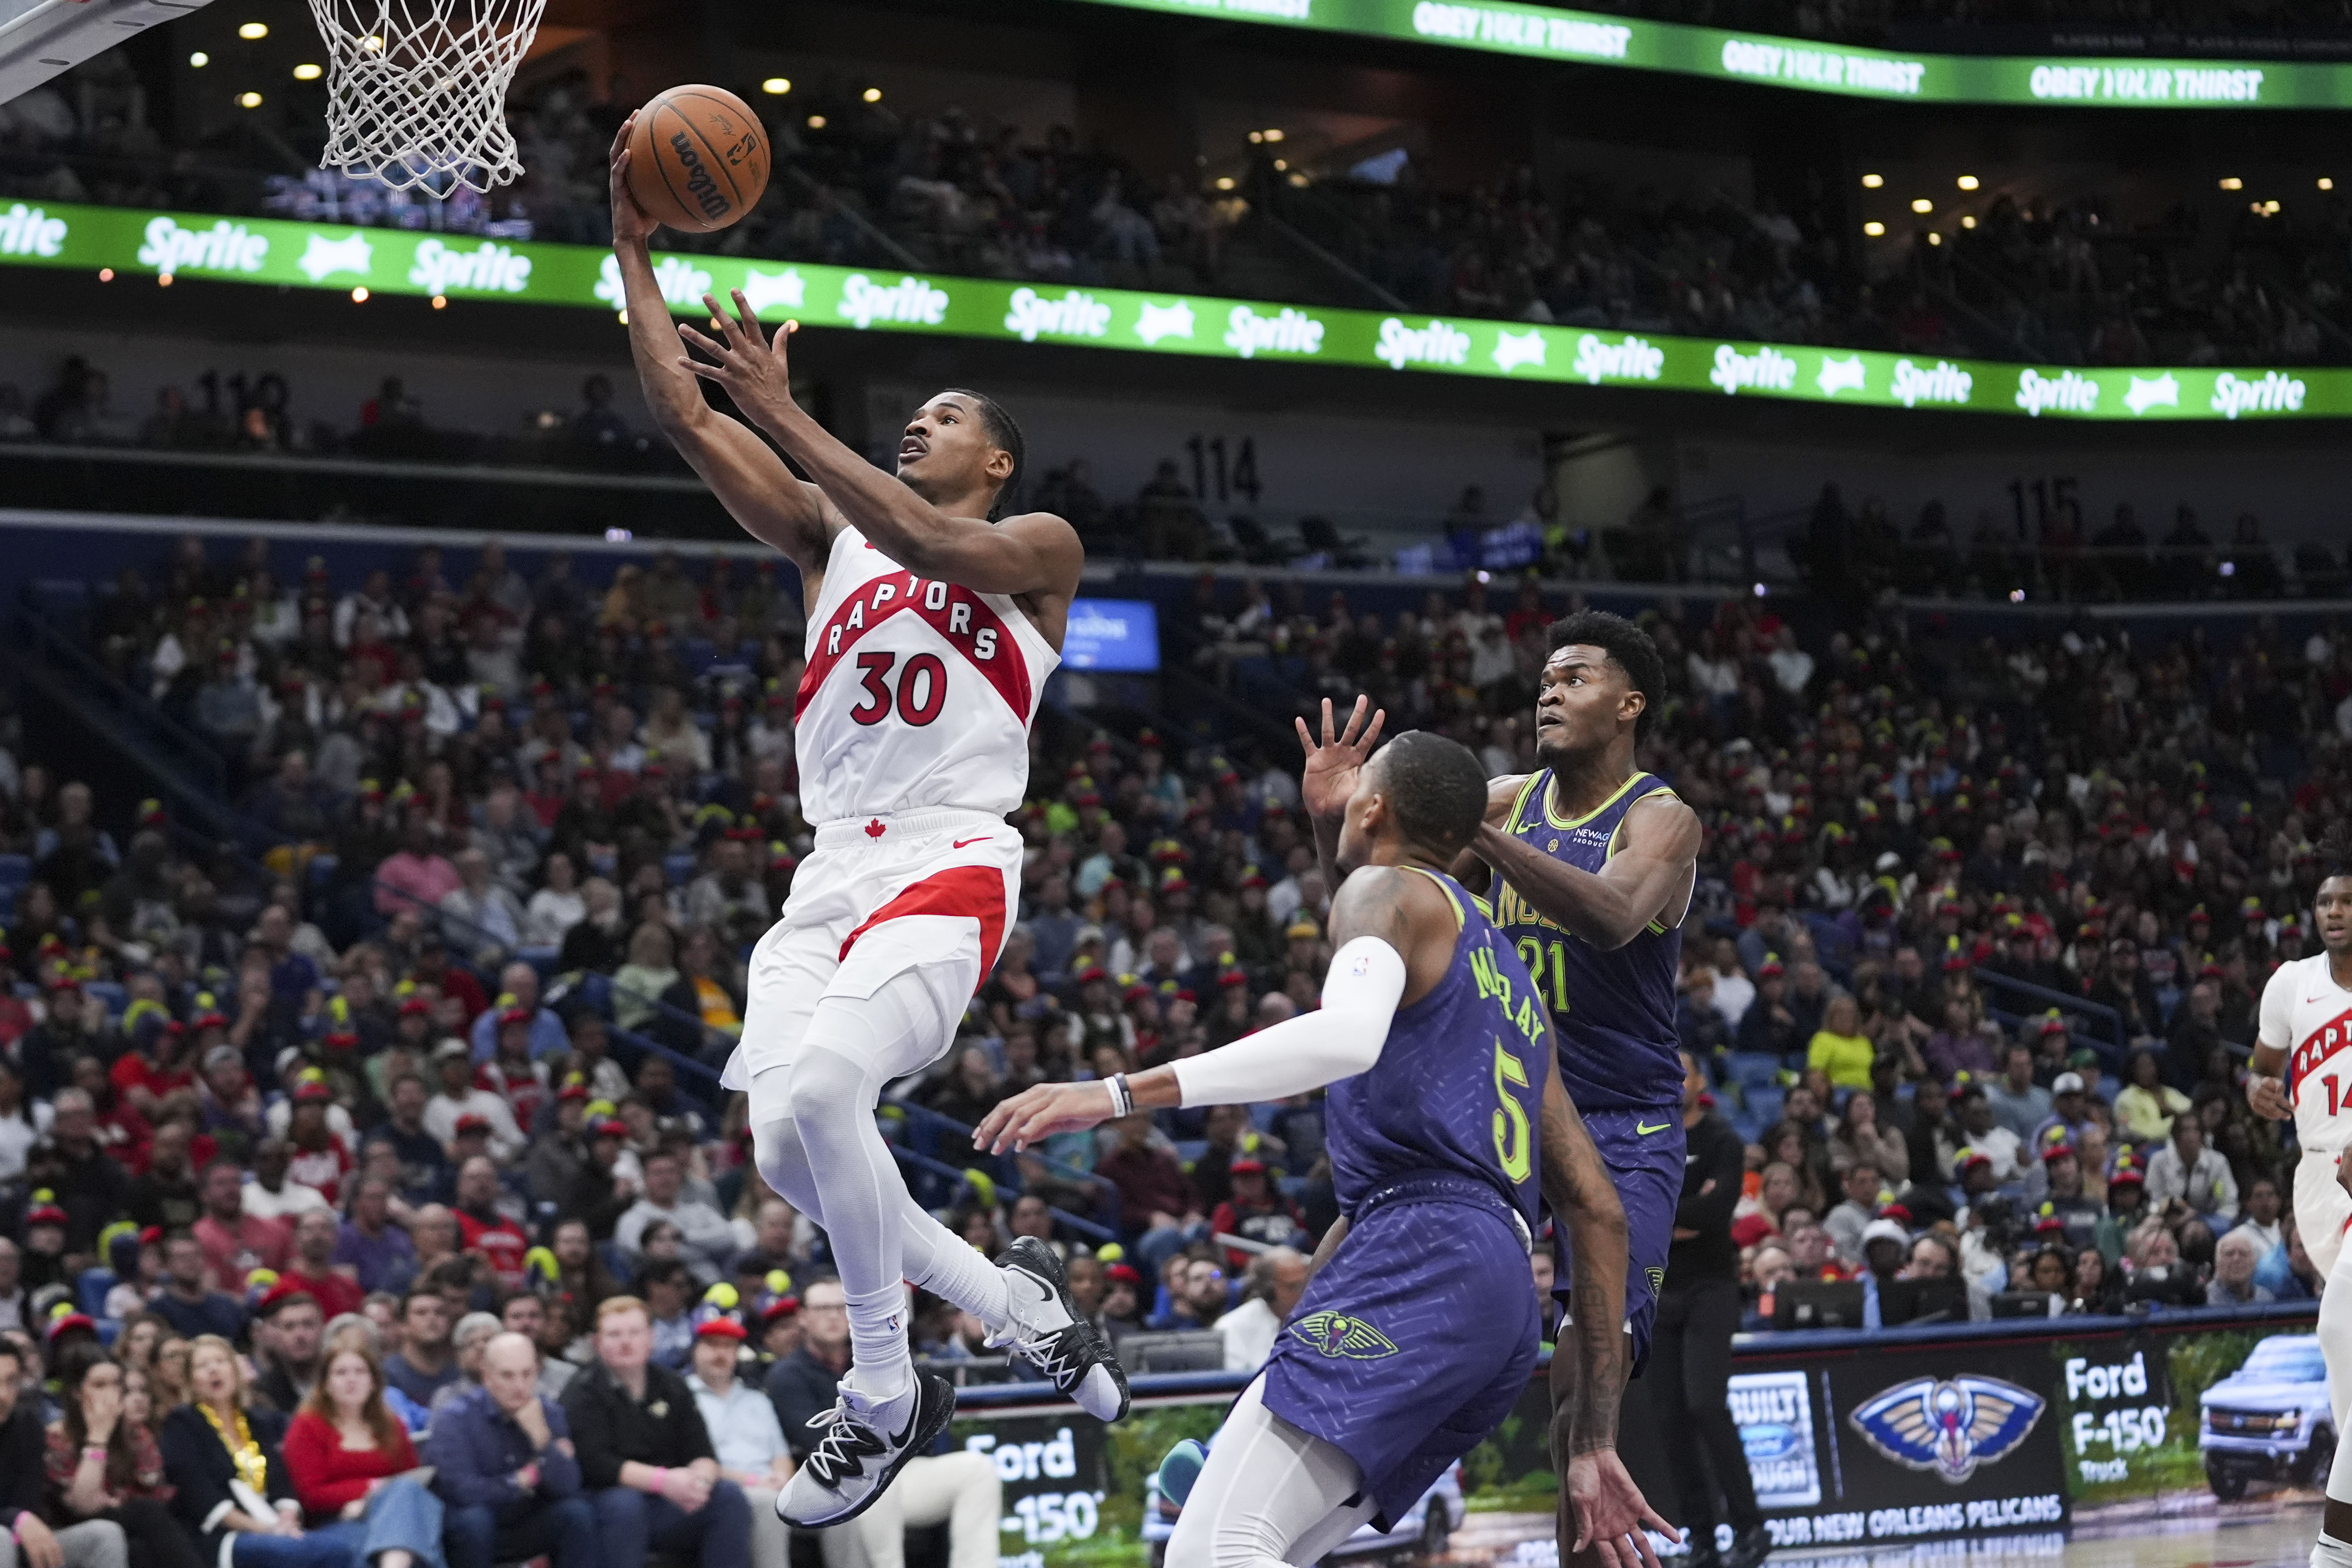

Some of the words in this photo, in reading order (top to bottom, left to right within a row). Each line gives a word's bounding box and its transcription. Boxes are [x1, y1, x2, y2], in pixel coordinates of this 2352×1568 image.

[2030, 66, 2100, 98] OBEY
[2173, 69, 2264, 101] THIRST
[139, 217, 270, 279] Sprite
[408, 239, 532, 296] Sprite
[593, 253, 713, 310] Site
[836, 274, 949, 329] Sprite
[1004, 287, 1112, 341] Sprite
[1223, 305, 1325, 358] Sprite
[1375, 317, 1472, 370] Sprite
[1573, 333, 1664, 384] Sprite
[1710, 345, 1798, 394] Sprite
[1890, 359, 1973, 408] Sprite
[2015, 369, 2100, 416] Sprite
[2210, 371, 2306, 419] Sprite
[1187, 435, 1264, 503] 114
[2007, 477, 2080, 543] 115
[827, 575, 998, 660] RAPTORS
[849, 651, 939, 727] 30
[1575, 828, 1612, 841] NEWAG
[1515, 935, 1570, 1013] 21
[1492, 1035, 1531, 1185] 5
[2065, 1350, 2148, 1402] Ford
[998, 1491, 1098, 1544] -150
[1814, 1511, 1865, 1541] NEW
[1868, 1503, 1964, 1538] ORLEANS
[1966, 1494, 2062, 1528] PELICANS
